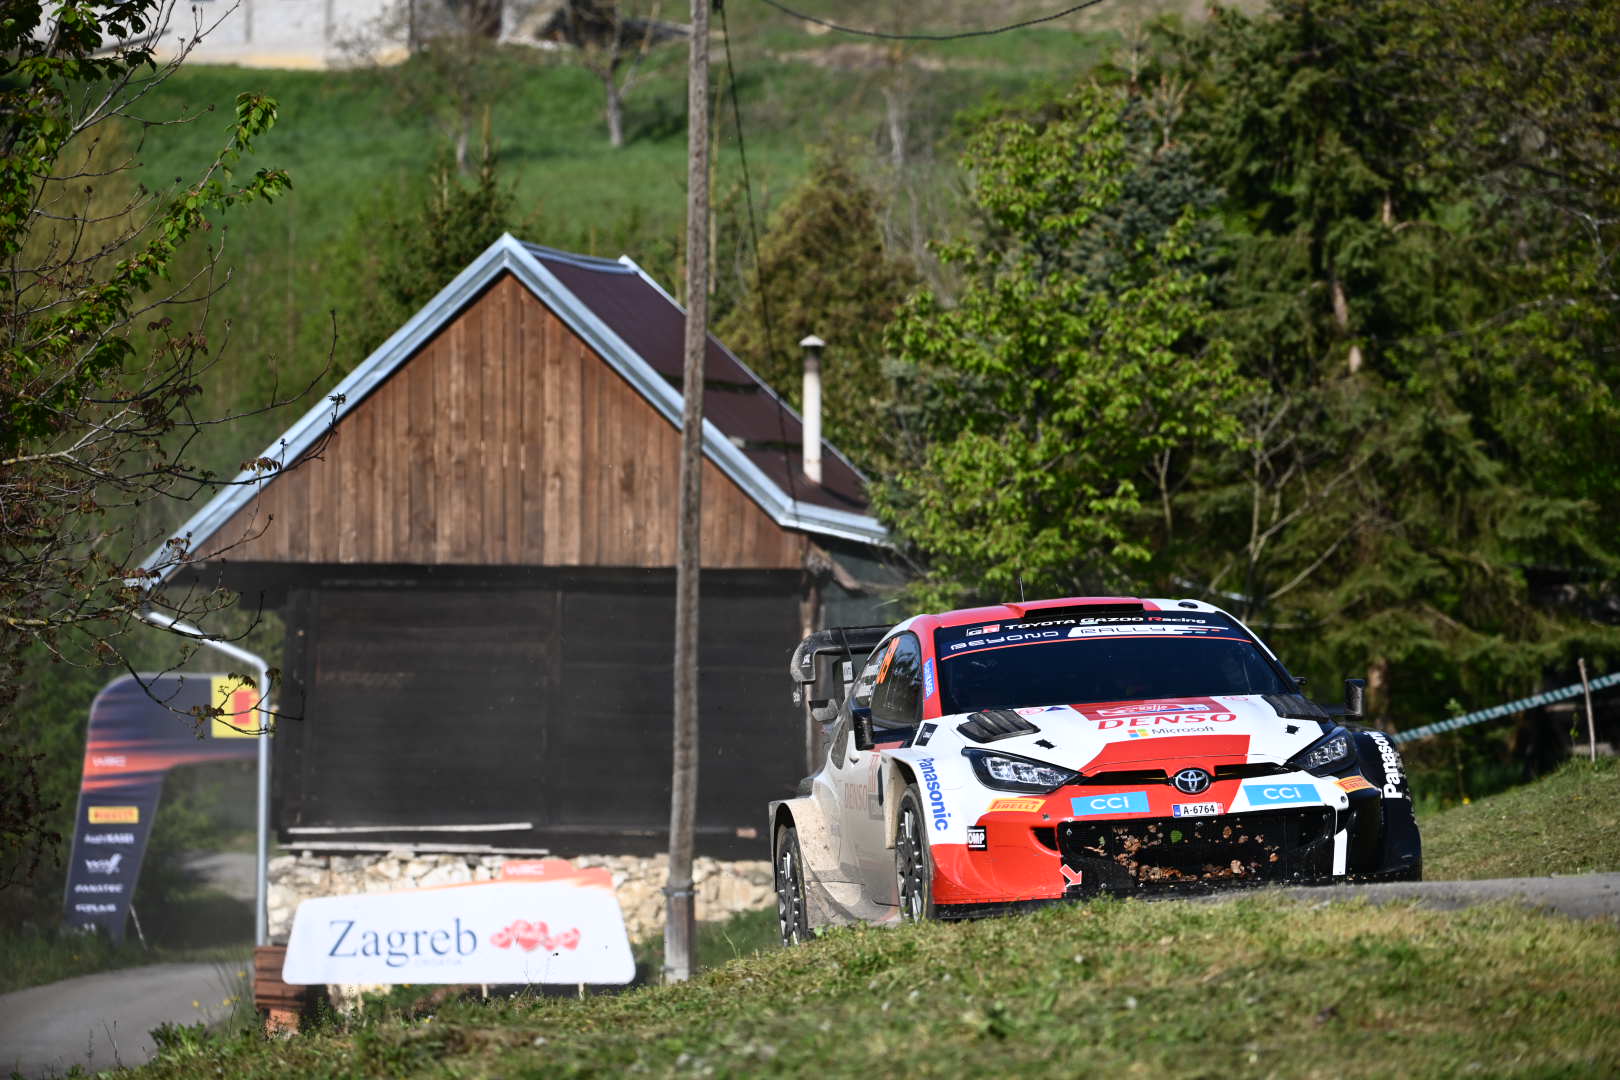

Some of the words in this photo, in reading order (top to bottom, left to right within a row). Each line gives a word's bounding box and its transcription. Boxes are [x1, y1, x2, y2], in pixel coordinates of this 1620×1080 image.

[1005, 619, 1075, 630] TOYOTA
[1080, 616, 1144, 625] GAZOO
[1148, 616, 1206, 624] Racing
[950, 630, 1059, 650] BEYOND
[1080, 626, 1166, 634] RALLY
[1097, 713, 1237, 730] DENSO
[1151, 725, 1215, 735] Microsoft
[1363, 730, 1402, 799] Panason
[917, 757, 952, 831] Panasonic
[1263, 786, 1302, 800] CCI
[990, 799, 1040, 810] PIRELLI
[1089, 796, 1129, 810] CCI
[1183, 804, 1216, 815] A-6764
[967, 834, 986, 845] OMP
[328, 917, 478, 968] Zagreb
